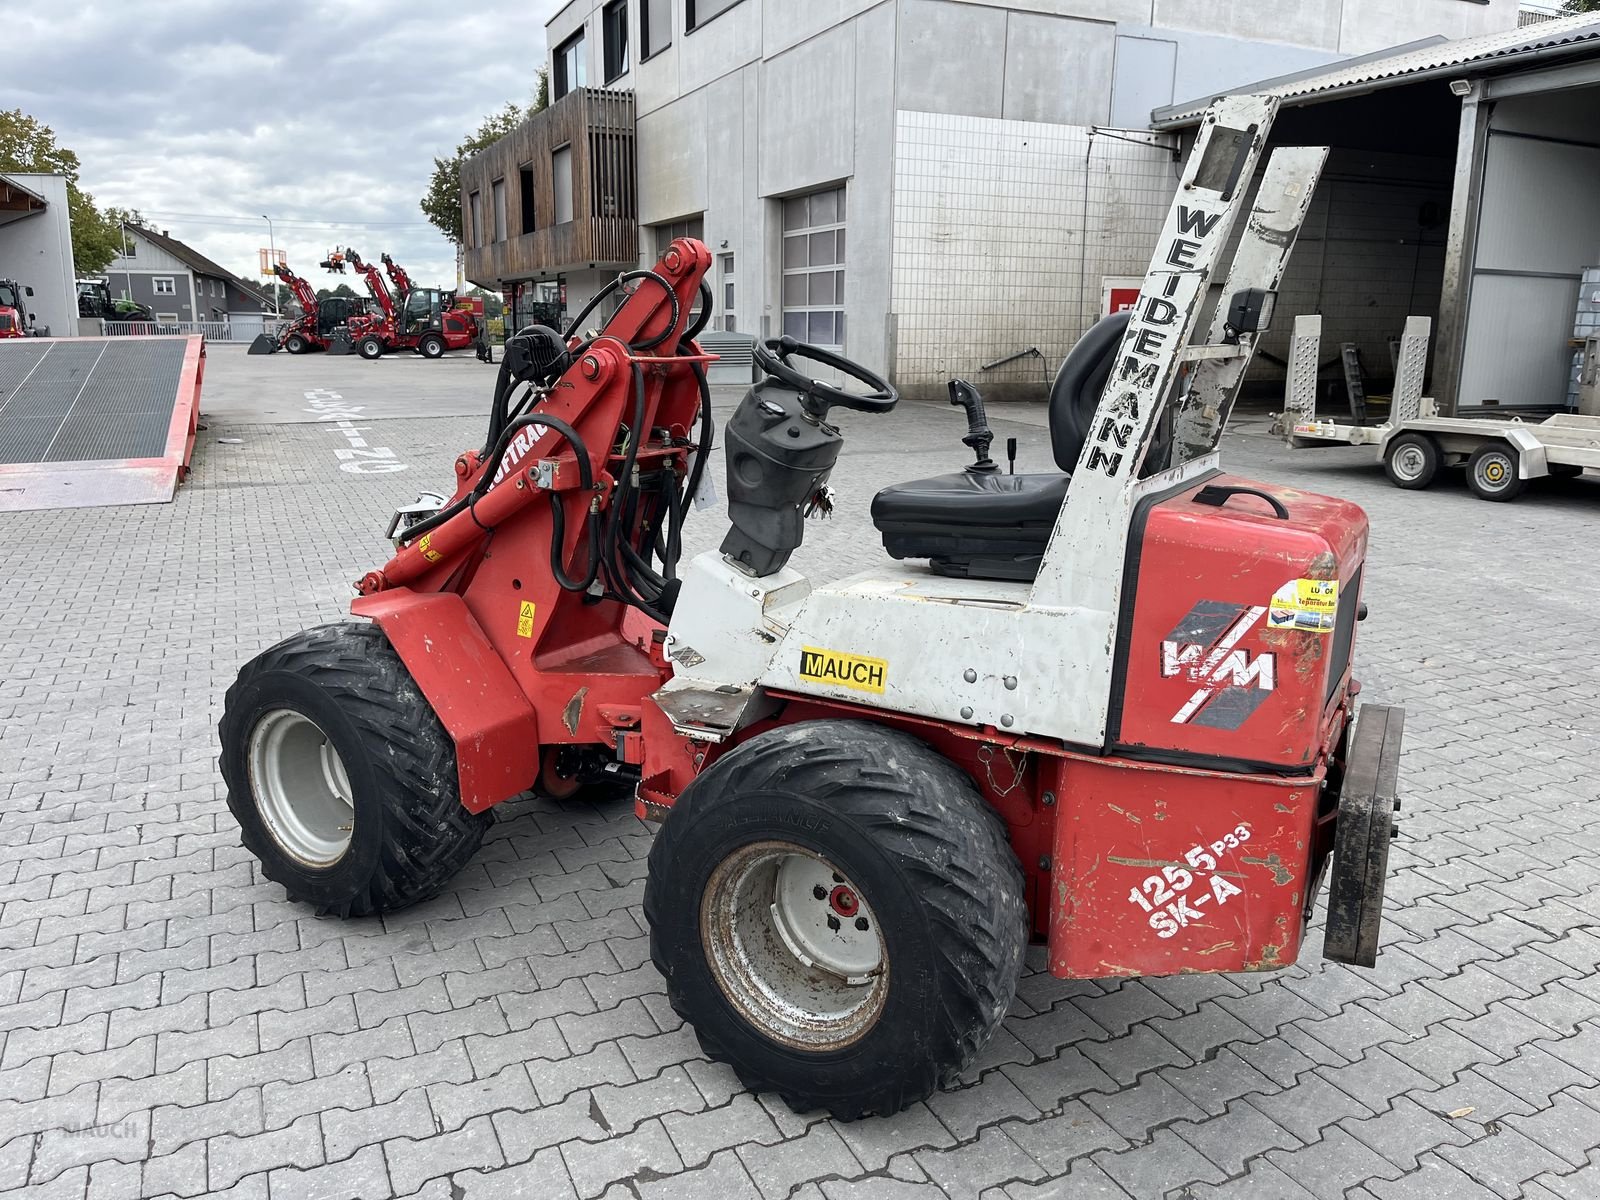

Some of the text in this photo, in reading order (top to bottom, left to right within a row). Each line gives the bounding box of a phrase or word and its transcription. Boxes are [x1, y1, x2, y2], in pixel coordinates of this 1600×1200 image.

[1086, 204, 1220, 478] WEIDEMANN
[805, 653, 883, 687] MAUCH
[1148, 874, 1243, 939] SK-A
